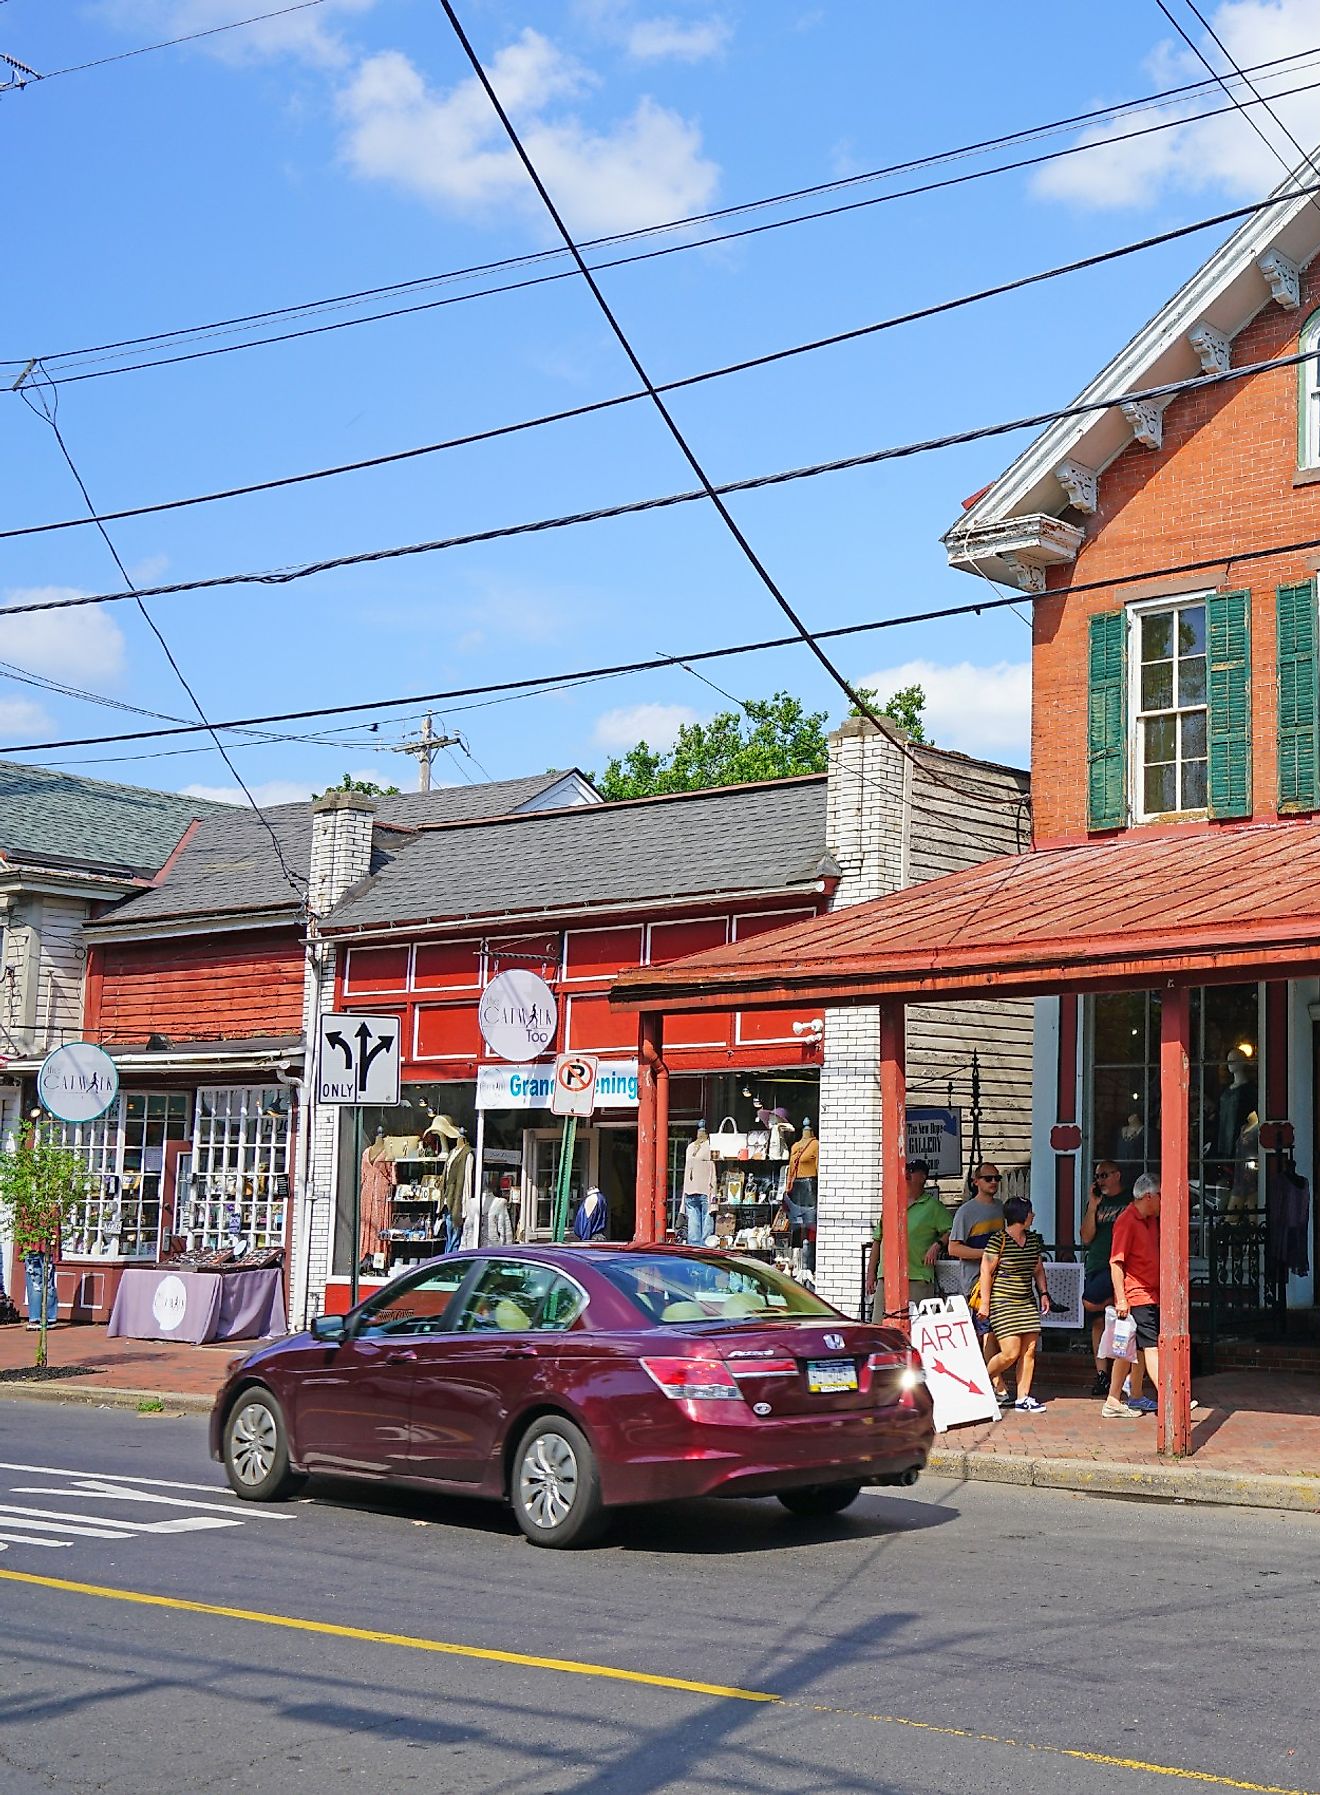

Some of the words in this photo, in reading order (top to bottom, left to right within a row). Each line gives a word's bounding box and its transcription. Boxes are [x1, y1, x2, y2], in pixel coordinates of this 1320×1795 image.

[526, 1029, 548, 1043] Too
[323, 1083, 354, 1098] ONLY
[510, 1073, 554, 1097] Gran
[909, 1136, 942, 1154] GALLERY
[921, 1321, 969, 1354] ART
